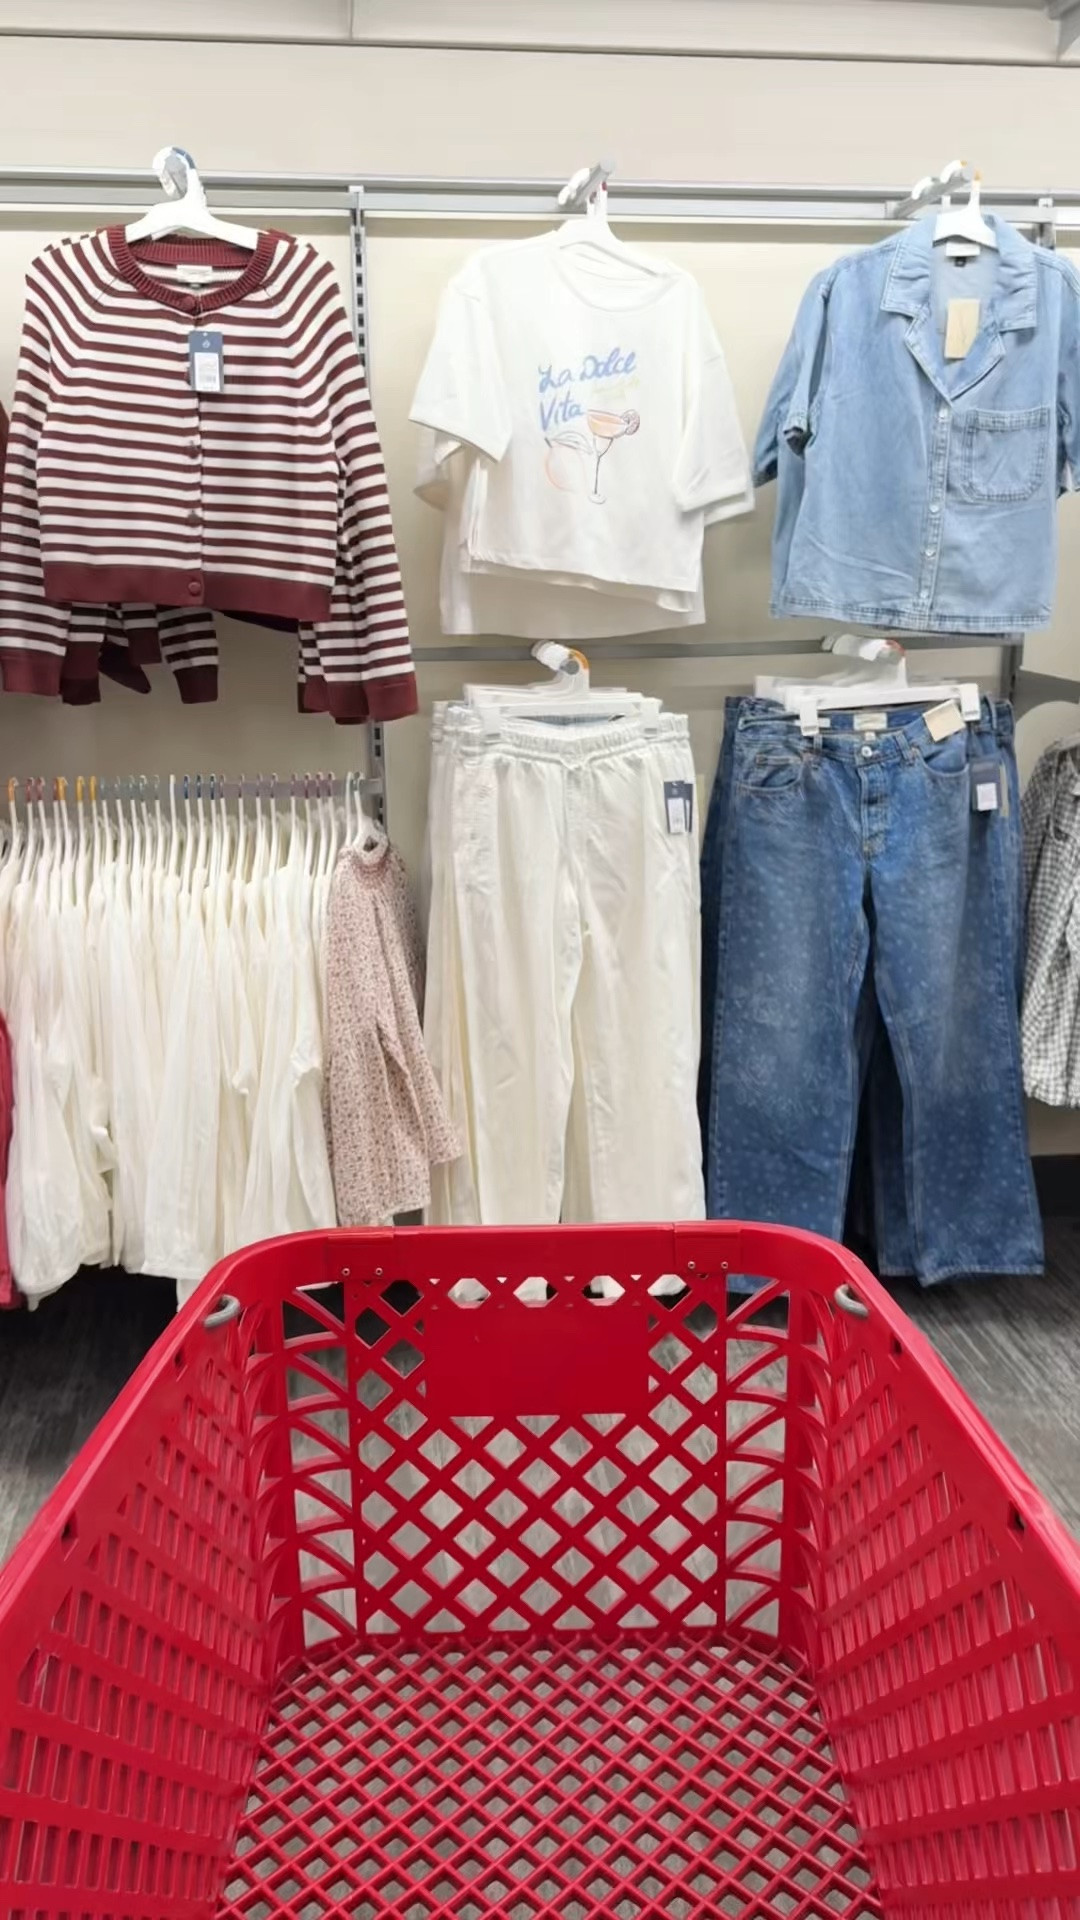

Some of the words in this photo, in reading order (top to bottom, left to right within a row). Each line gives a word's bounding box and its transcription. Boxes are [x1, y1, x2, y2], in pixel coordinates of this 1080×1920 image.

[538, 365, 574, 393] La
[580, 347, 637, 381] Dolce
[540, 389, 584, 432] Vita
